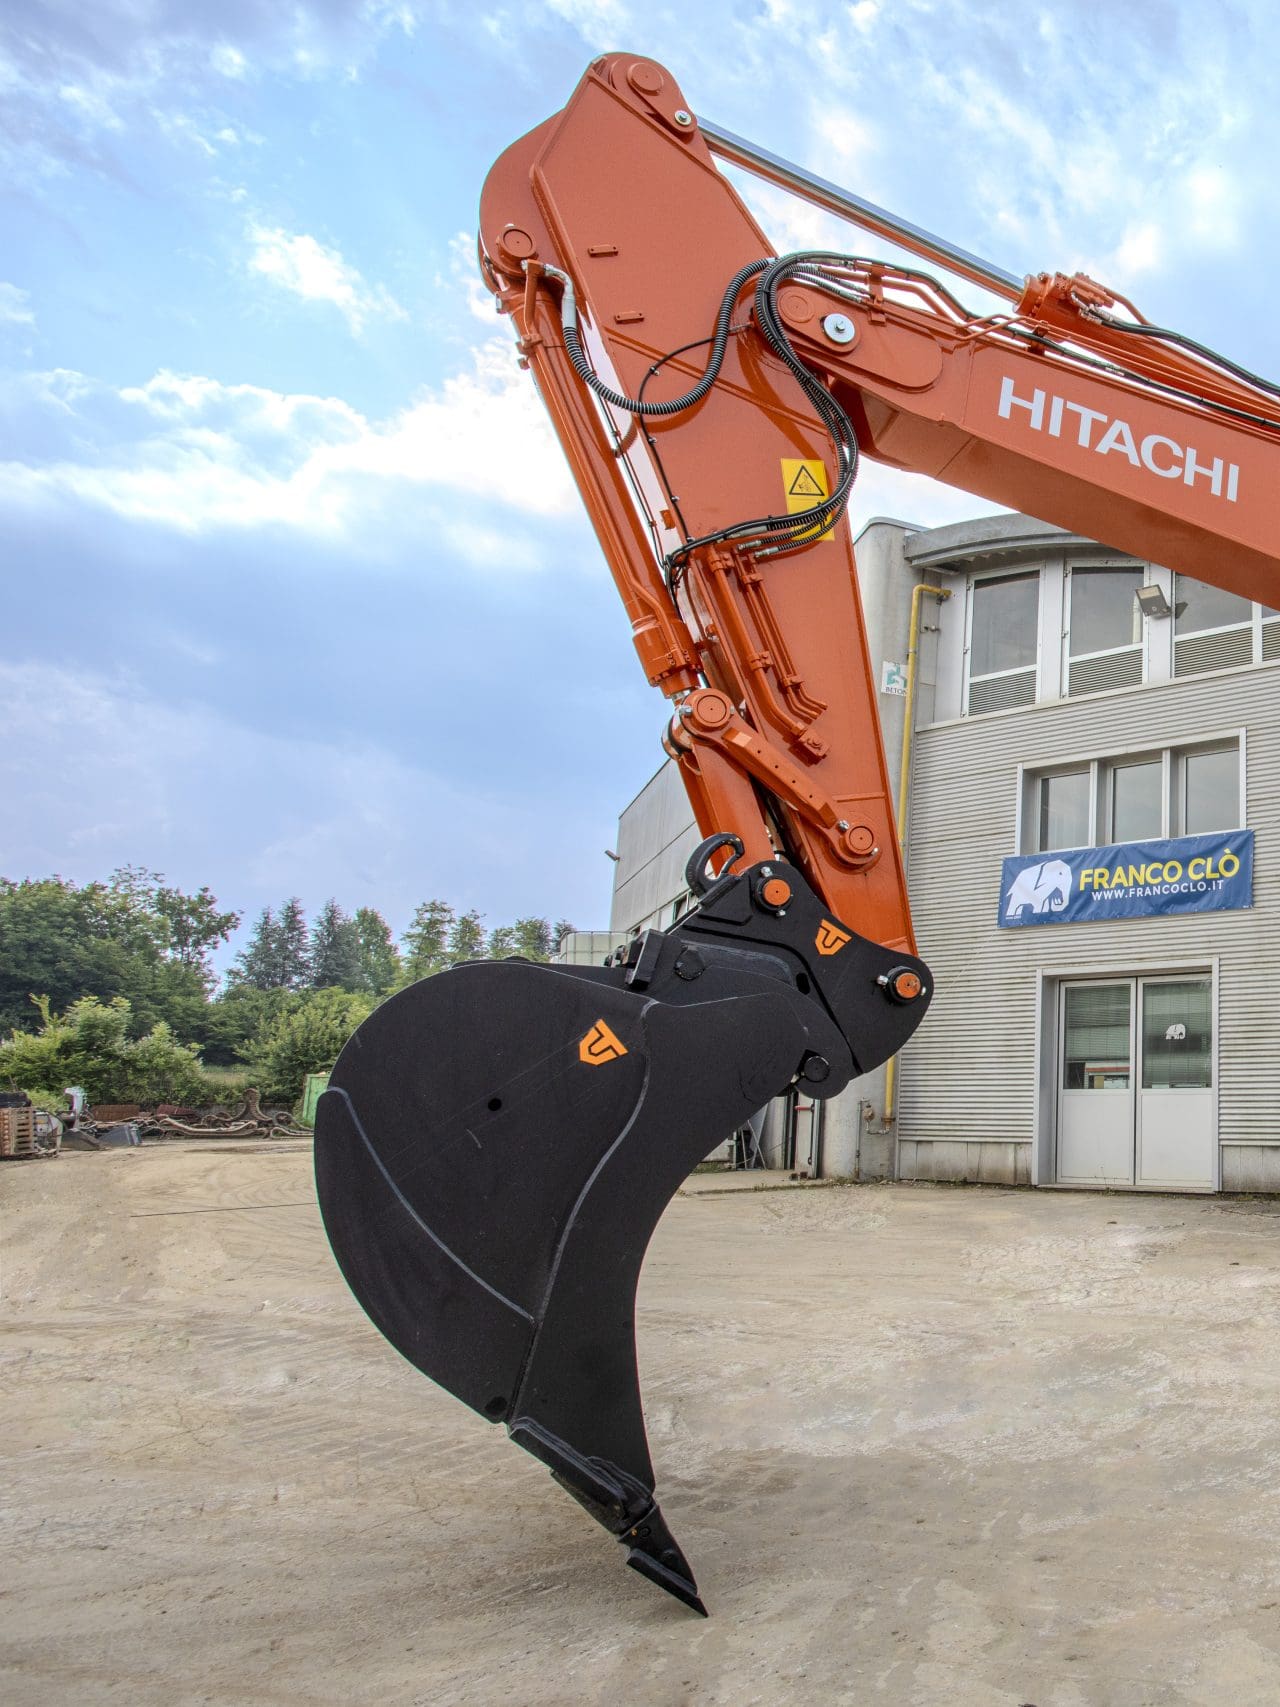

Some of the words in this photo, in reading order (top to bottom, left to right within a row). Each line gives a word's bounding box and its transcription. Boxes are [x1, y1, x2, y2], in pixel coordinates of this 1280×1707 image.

[998, 376, 1239, 502] HITACHI
[1079, 860, 1183, 891] FRANCO
[1188, 848, 1240, 880] CLÒ
[1092, 880, 1224, 901] WWW.FRANCOCLO.IT
